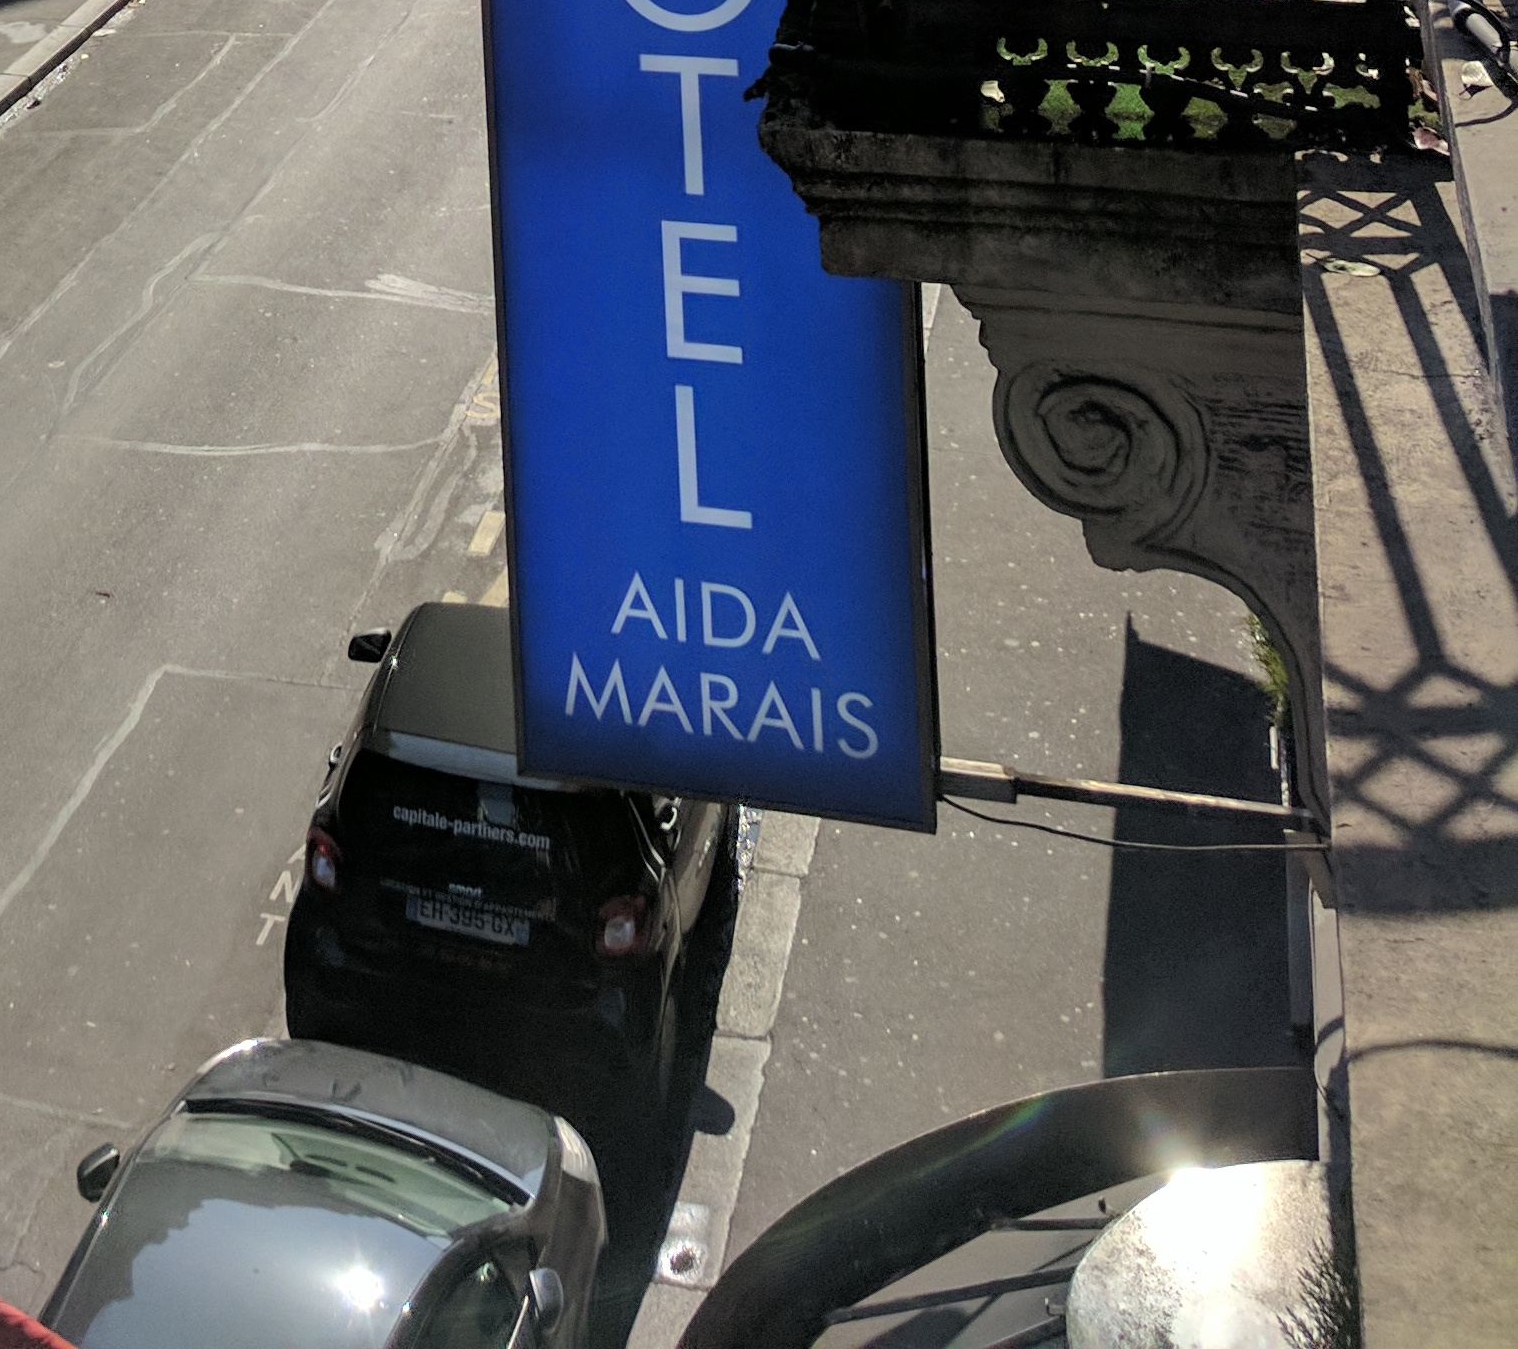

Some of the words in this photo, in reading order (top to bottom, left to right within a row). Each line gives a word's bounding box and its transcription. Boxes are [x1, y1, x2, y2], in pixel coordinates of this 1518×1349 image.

[610, 571, 821, 661] AIDA
[565, 652, 879, 760] MARAIS
[393, 805, 550, 850] capitale-partners.com
